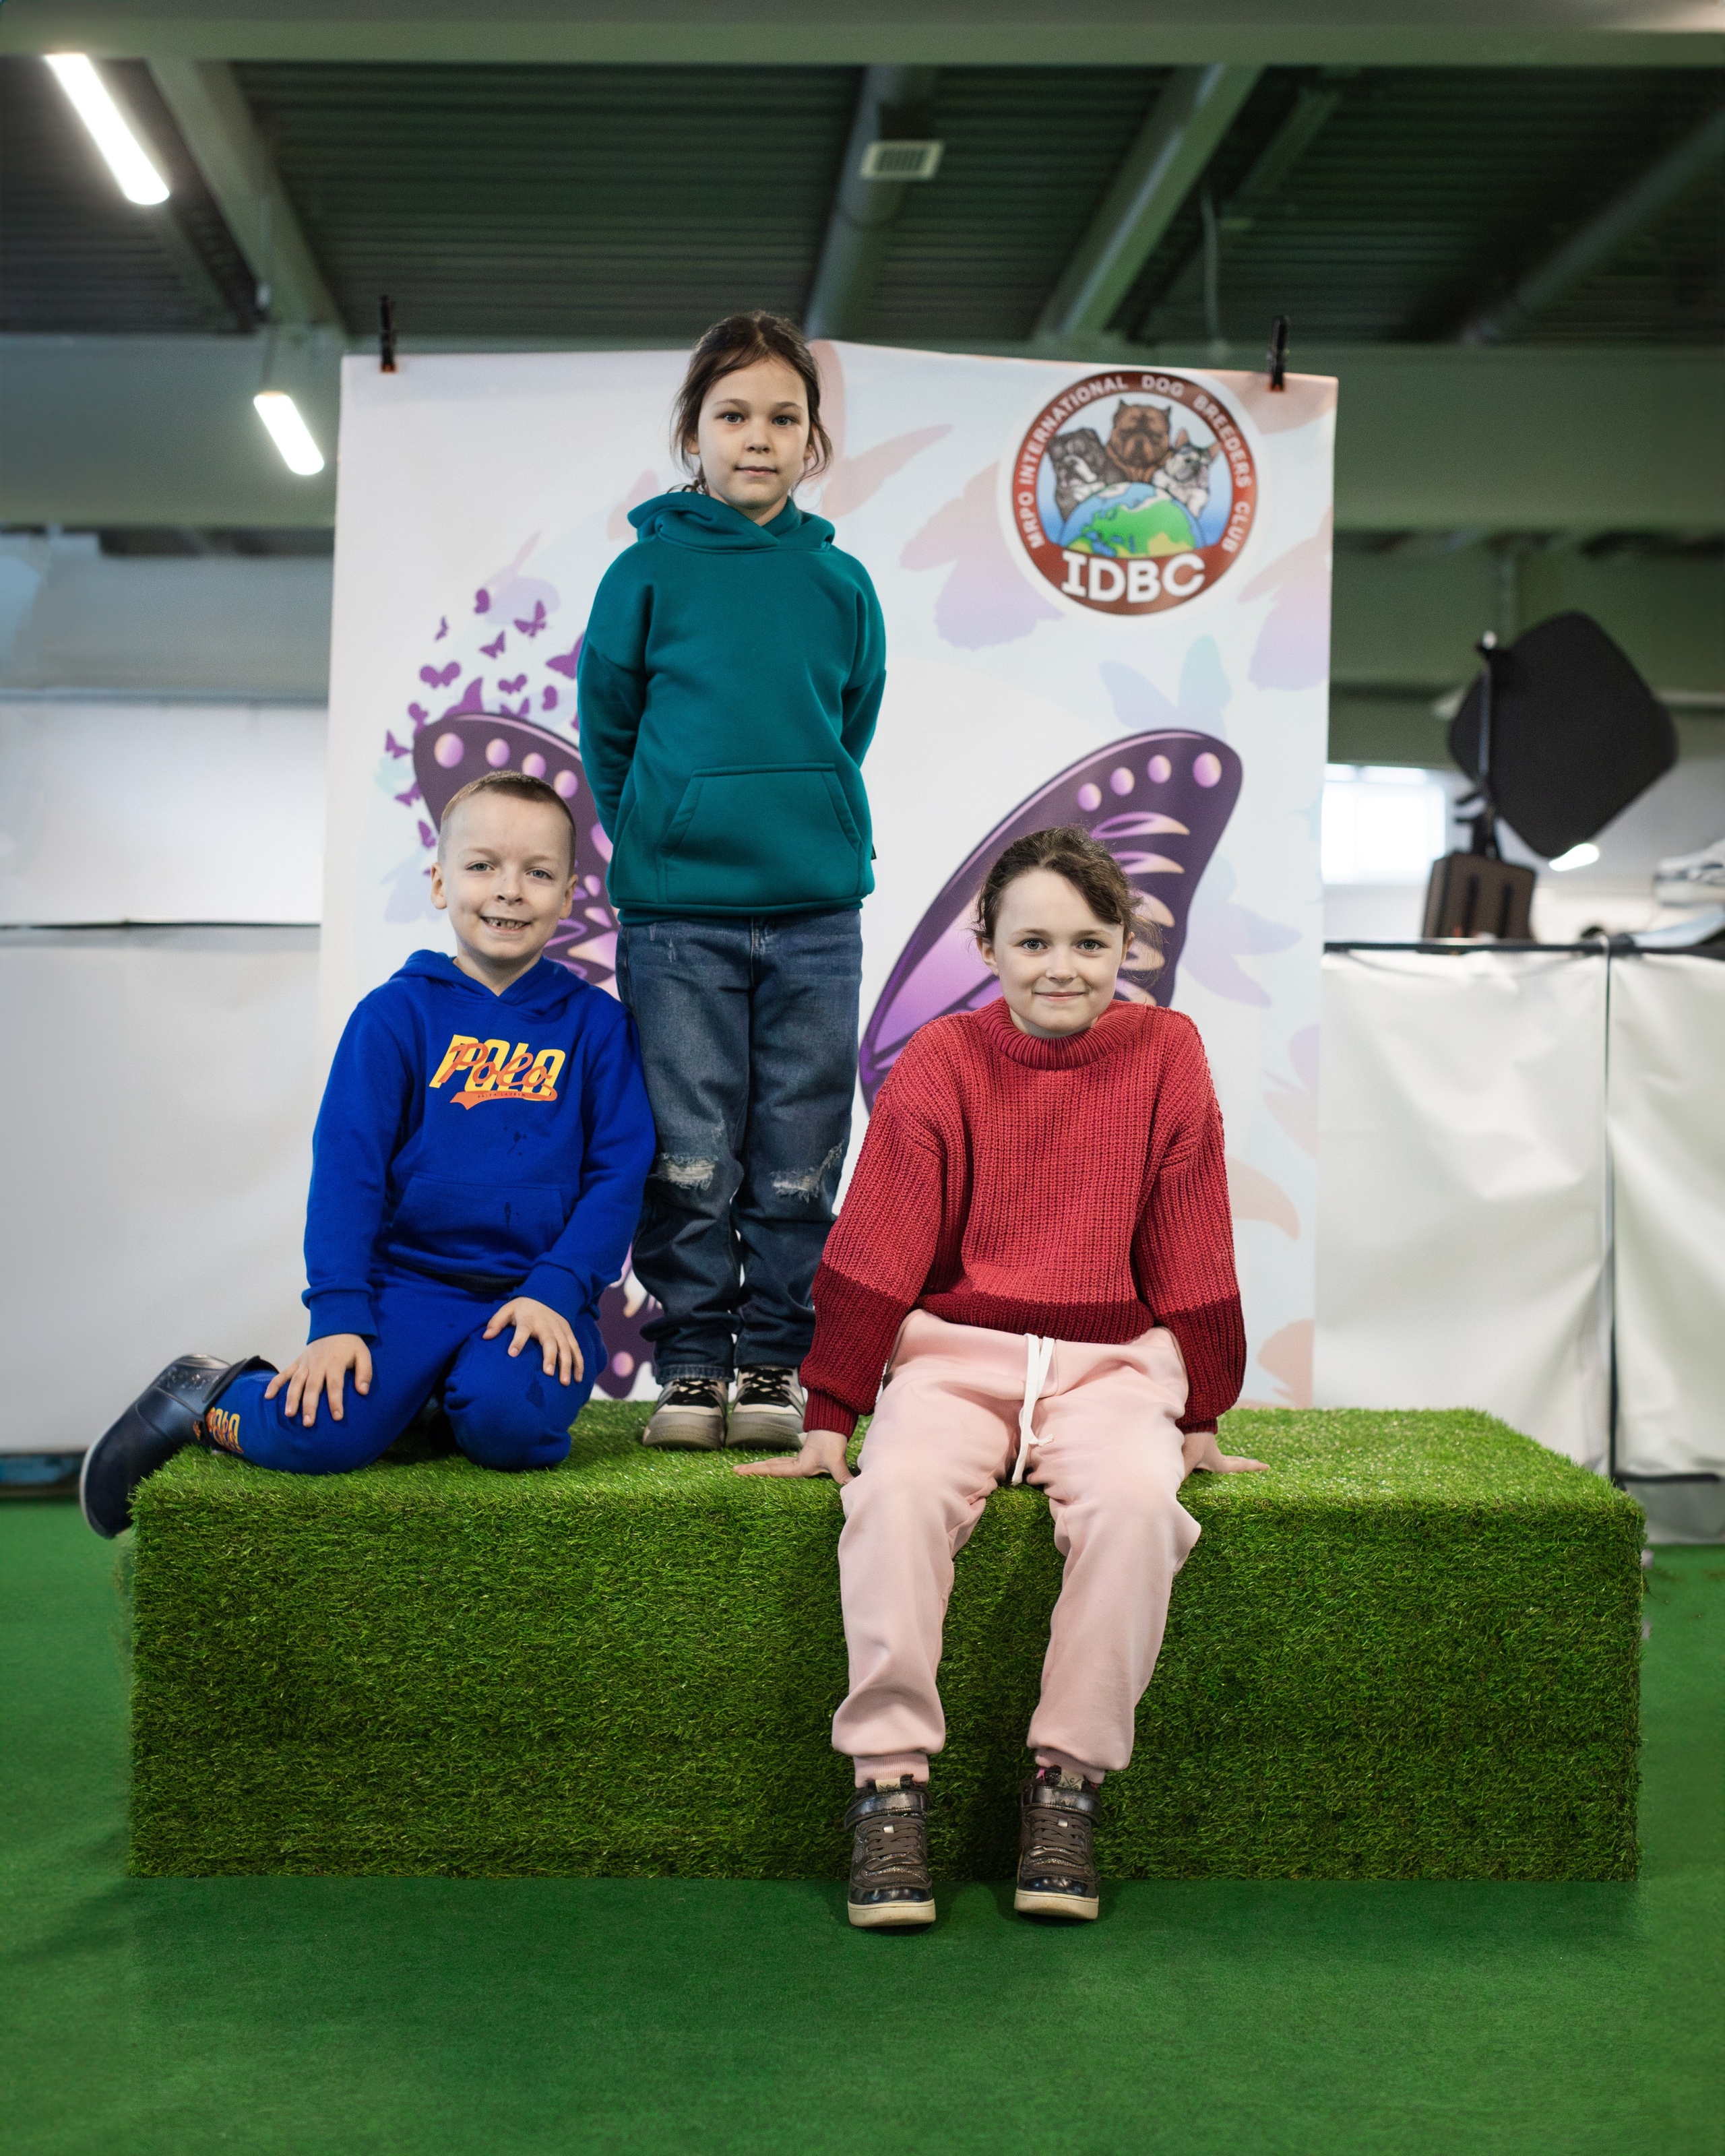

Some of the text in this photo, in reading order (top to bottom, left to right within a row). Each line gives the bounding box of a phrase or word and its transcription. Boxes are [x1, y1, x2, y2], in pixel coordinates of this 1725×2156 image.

[1141, 374, 1185, 398] DOG
[1018, 375, 1129, 485] INTERNATIONAL
[1193, 394, 1253, 488] BREEDERS
[1222, 501, 1251, 553] CLUB
[1061, 552, 1205, 603] IDBC
[429, 1034, 566, 1102] POLO
[437, 1042, 554, 1088] Polo
